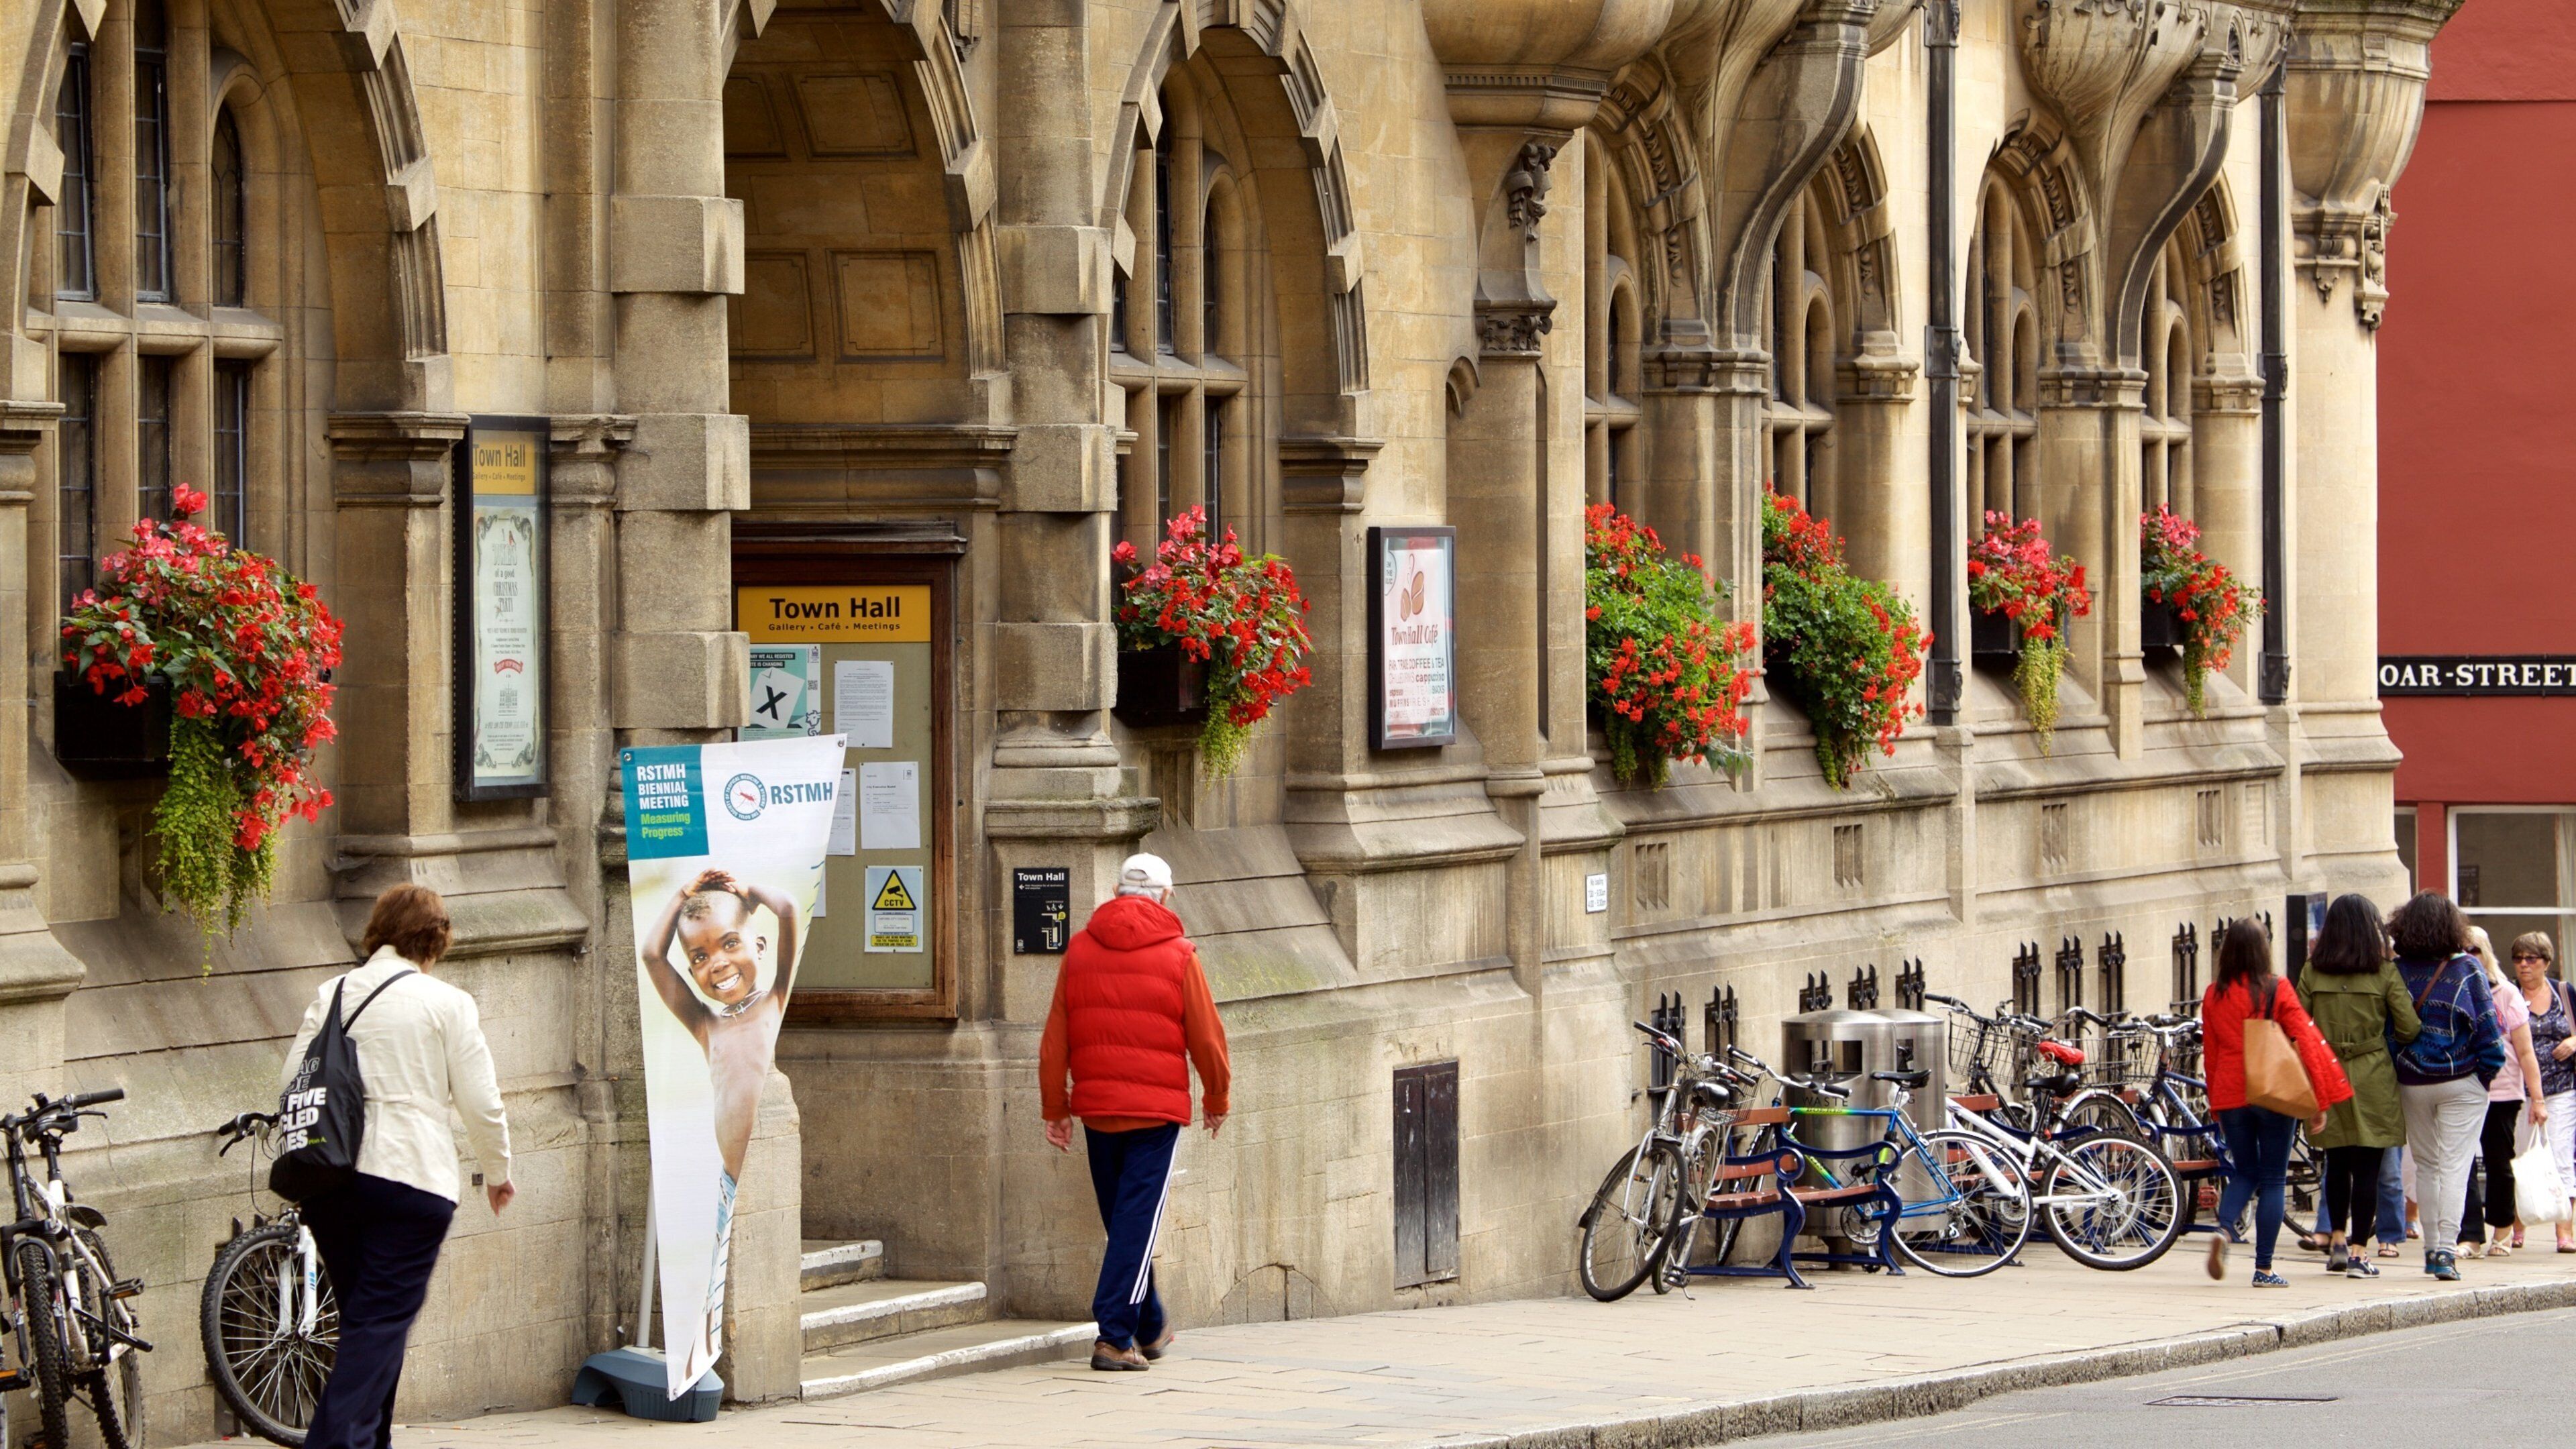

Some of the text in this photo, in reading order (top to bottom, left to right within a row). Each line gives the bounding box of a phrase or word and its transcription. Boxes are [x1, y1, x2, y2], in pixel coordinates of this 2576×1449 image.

[472, 444, 525, 467] Town Hall
[492, 472, 502, 480] Café
[506, 473, 526, 482] Meetings
[504, 569, 515, 579] good
[493, 582, 518, 596] CHRISTMAS
[769, 596, 900, 619] Town Hall
[769, 622, 900, 631] Gallery Café Meetings
[1409, 657, 1430, 669] COFFEE
[1435, 657, 1444, 668] TEA
[1415, 672, 1445, 684] cappuccino
[1389, 698, 1409, 708] MUFFINS
[637, 763, 686, 782] RSTMH
[638, 781, 688, 796] BIENNIAL
[770, 782, 833, 804] RSTMH
[639, 794, 689, 810] MEETING
[641, 812, 690, 825] Measuring
[642, 826, 683, 839] Progress
[1018, 872, 1065, 881] Town Hall
[299, 1057, 321, 1075] AG
[287, 1087, 327, 1112] FIVE
[1802, 1096, 1849, 1107] WASTE
[280, 1106, 319, 1134] CLED
